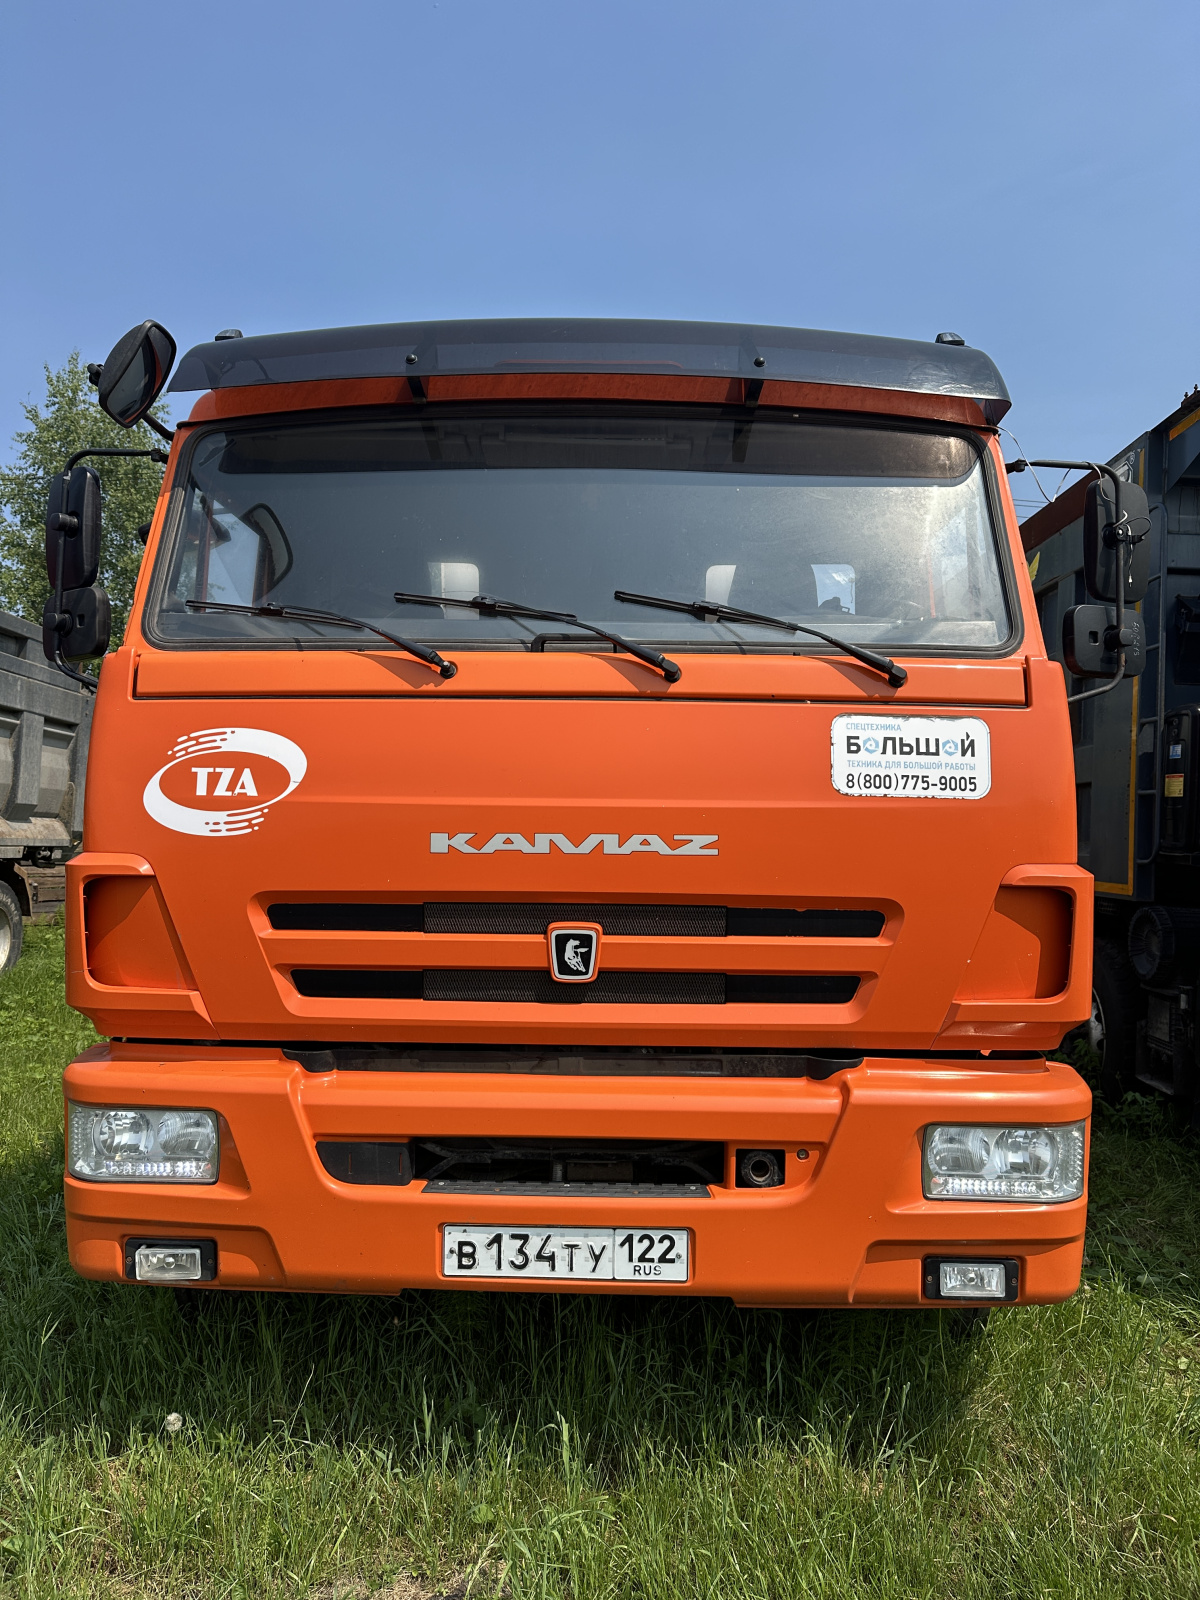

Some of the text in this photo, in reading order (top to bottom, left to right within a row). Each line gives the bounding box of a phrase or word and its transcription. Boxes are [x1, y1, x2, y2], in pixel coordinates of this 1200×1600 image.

[846, 722, 902, 731] СПЕЦТЕХНИКА
[846, 731, 976, 758] БОЛЬШОЙ
[847, 759, 976, 771] ТЕХНИКА ДЛЯ БОЛЬШОЙ РАБОТЫ
[191, 767, 258, 796] TZA
[846, 772, 977, 792] 8(800)775-9005
[430, 832, 719, 856] KAMAZ
[618, 1233, 676, 1264] 122
[633, 1265, 662, 1276] RUS
